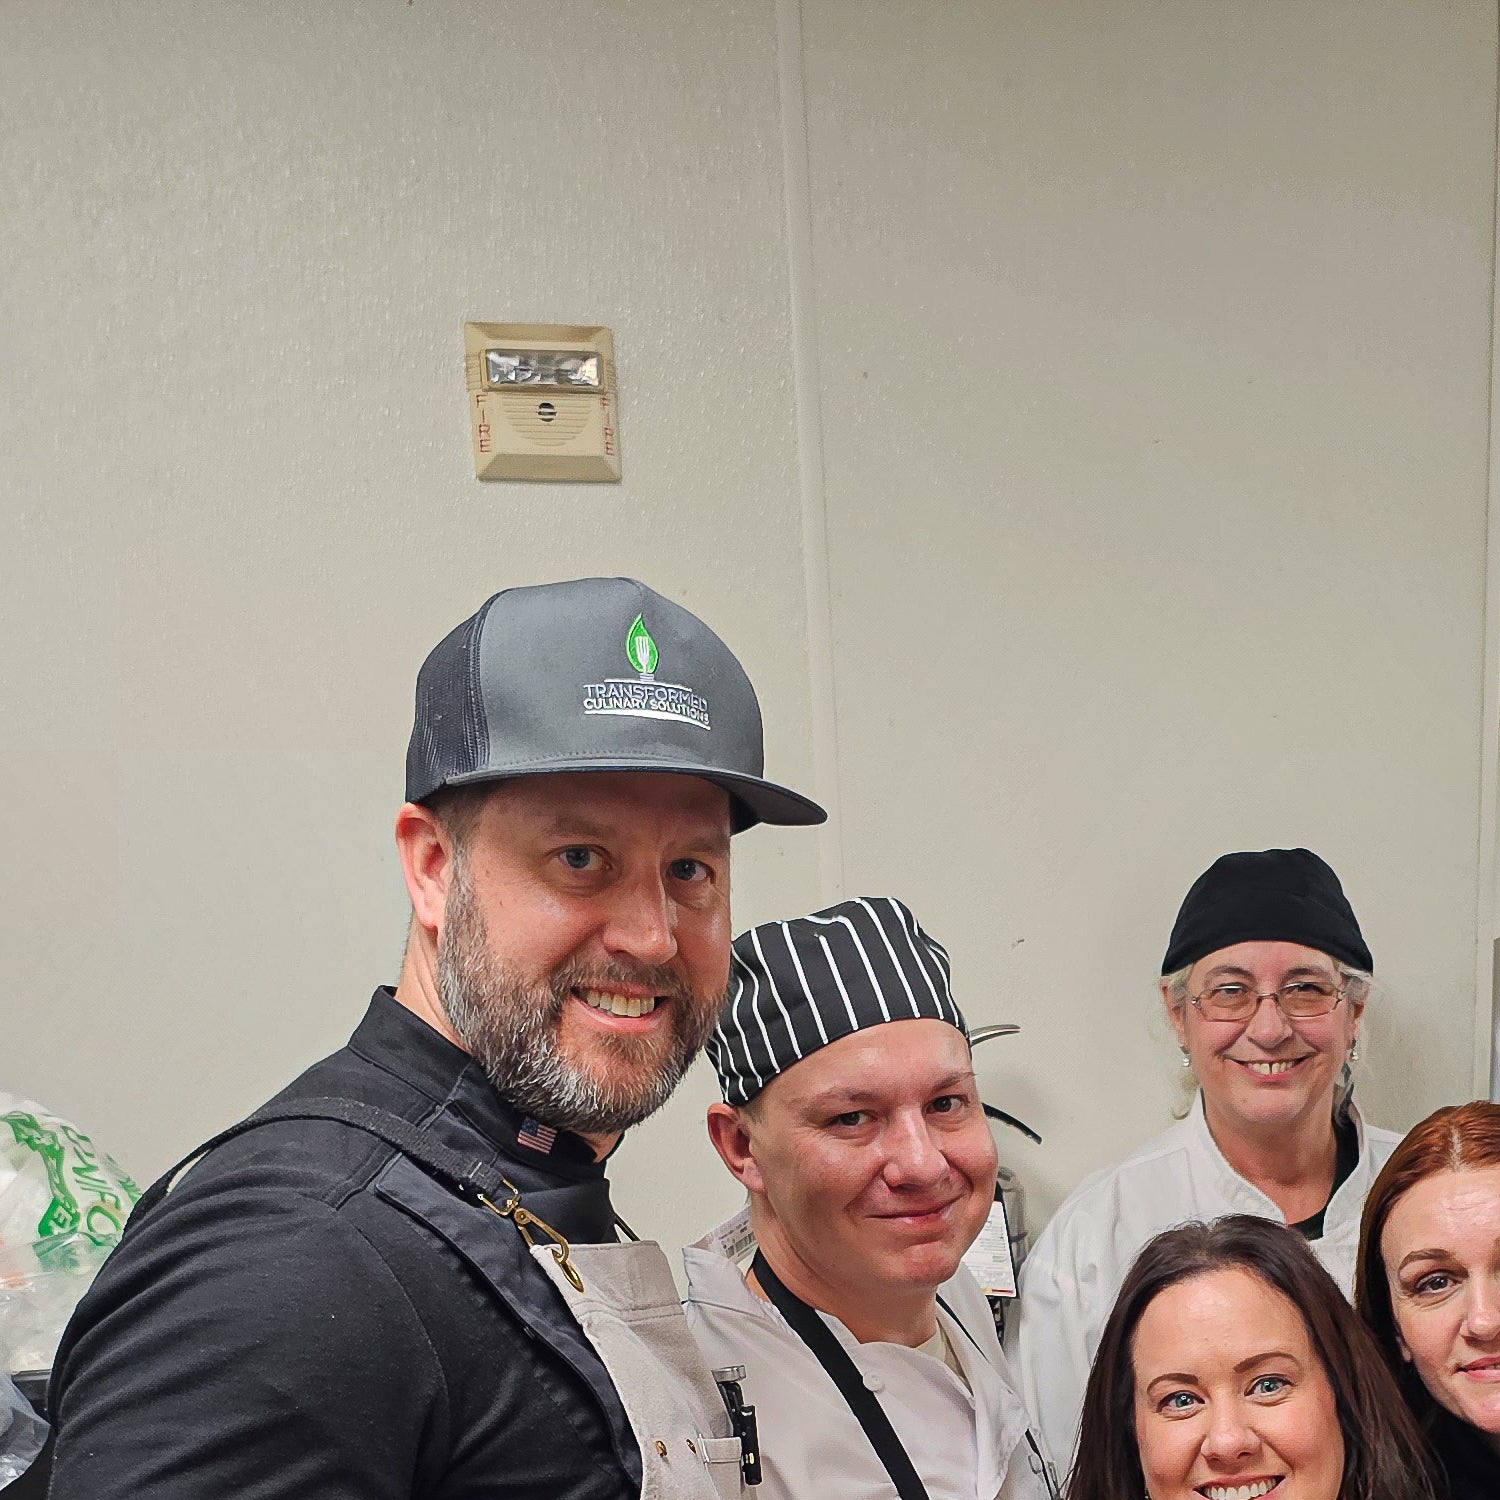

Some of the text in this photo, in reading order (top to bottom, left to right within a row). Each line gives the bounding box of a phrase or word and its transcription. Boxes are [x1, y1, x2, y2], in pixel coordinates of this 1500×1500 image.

[476, 393, 491, 453] FIRE
[600, 393, 614, 456] FIRE
[583, 698, 709, 724] CULINARY SOLUTIONS
[584, 683, 707, 711] TRANSFORMED
